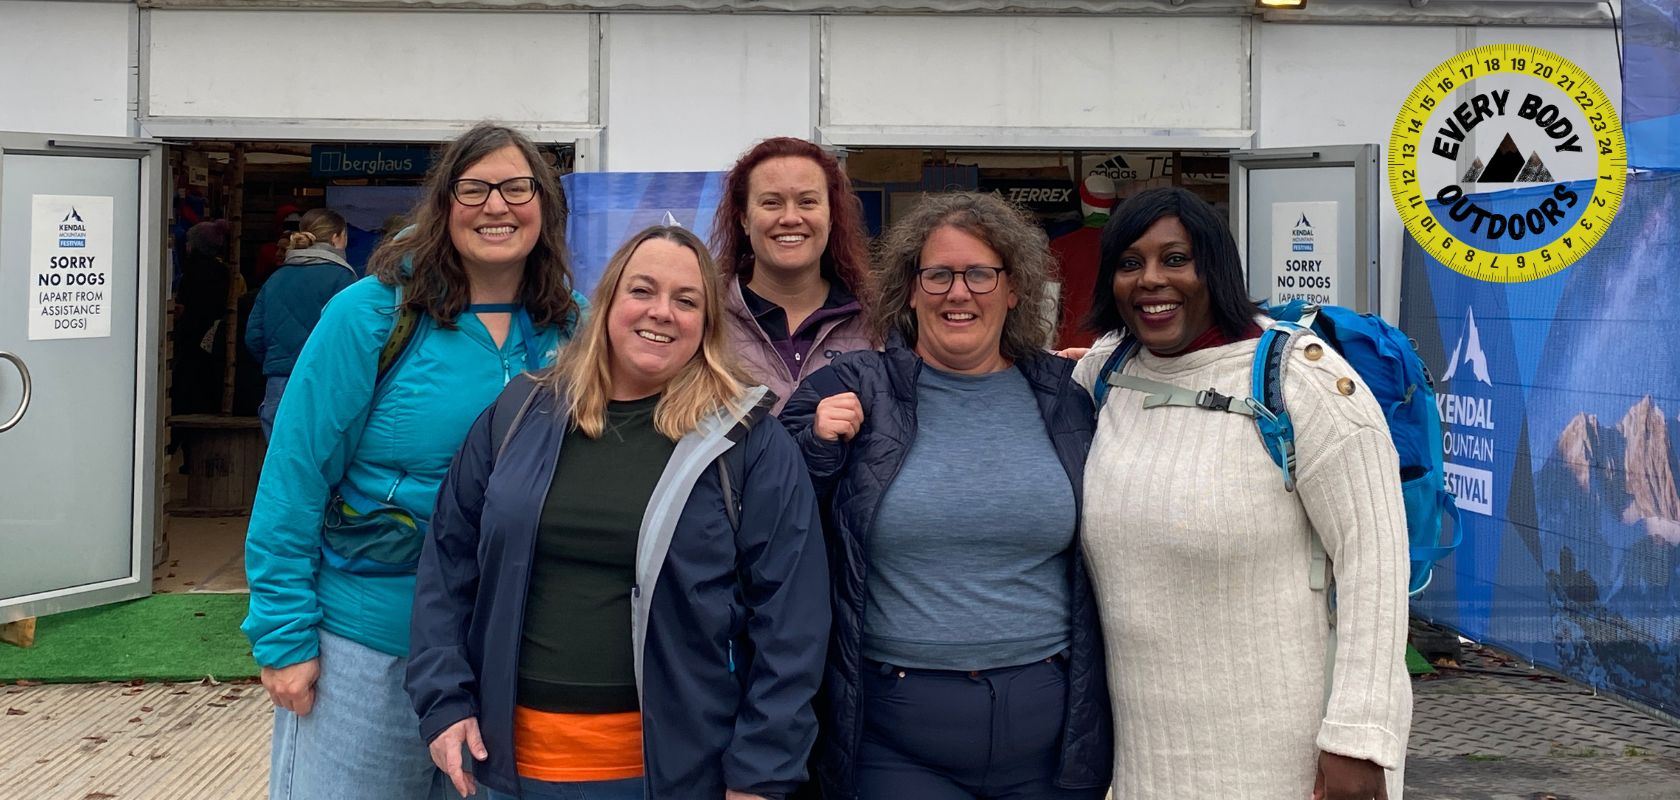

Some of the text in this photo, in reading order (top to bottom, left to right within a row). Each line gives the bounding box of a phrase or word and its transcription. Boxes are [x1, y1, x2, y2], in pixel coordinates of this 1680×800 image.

[342, 151, 412, 174] berghaus
[1008, 187, 1073, 202] TERREX
[59, 224, 86, 232] KENDAL
[50, 256, 95, 269] SORRY
[1286, 260, 1322, 272] SORRY
[38, 273, 105, 286] NO DOGS
[1277, 276, 1331, 289] NO DOGS
[39, 291, 103, 304] (APART FROM
[1306, 293, 1330, 304] FROM
[41, 304, 101, 316] ASSISTANCE
[54, 318, 87, 330] DOGS)
[1435, 392, 1495, 430] KENDAL
[1443, 431, 1494, 463] OUNTAIN
